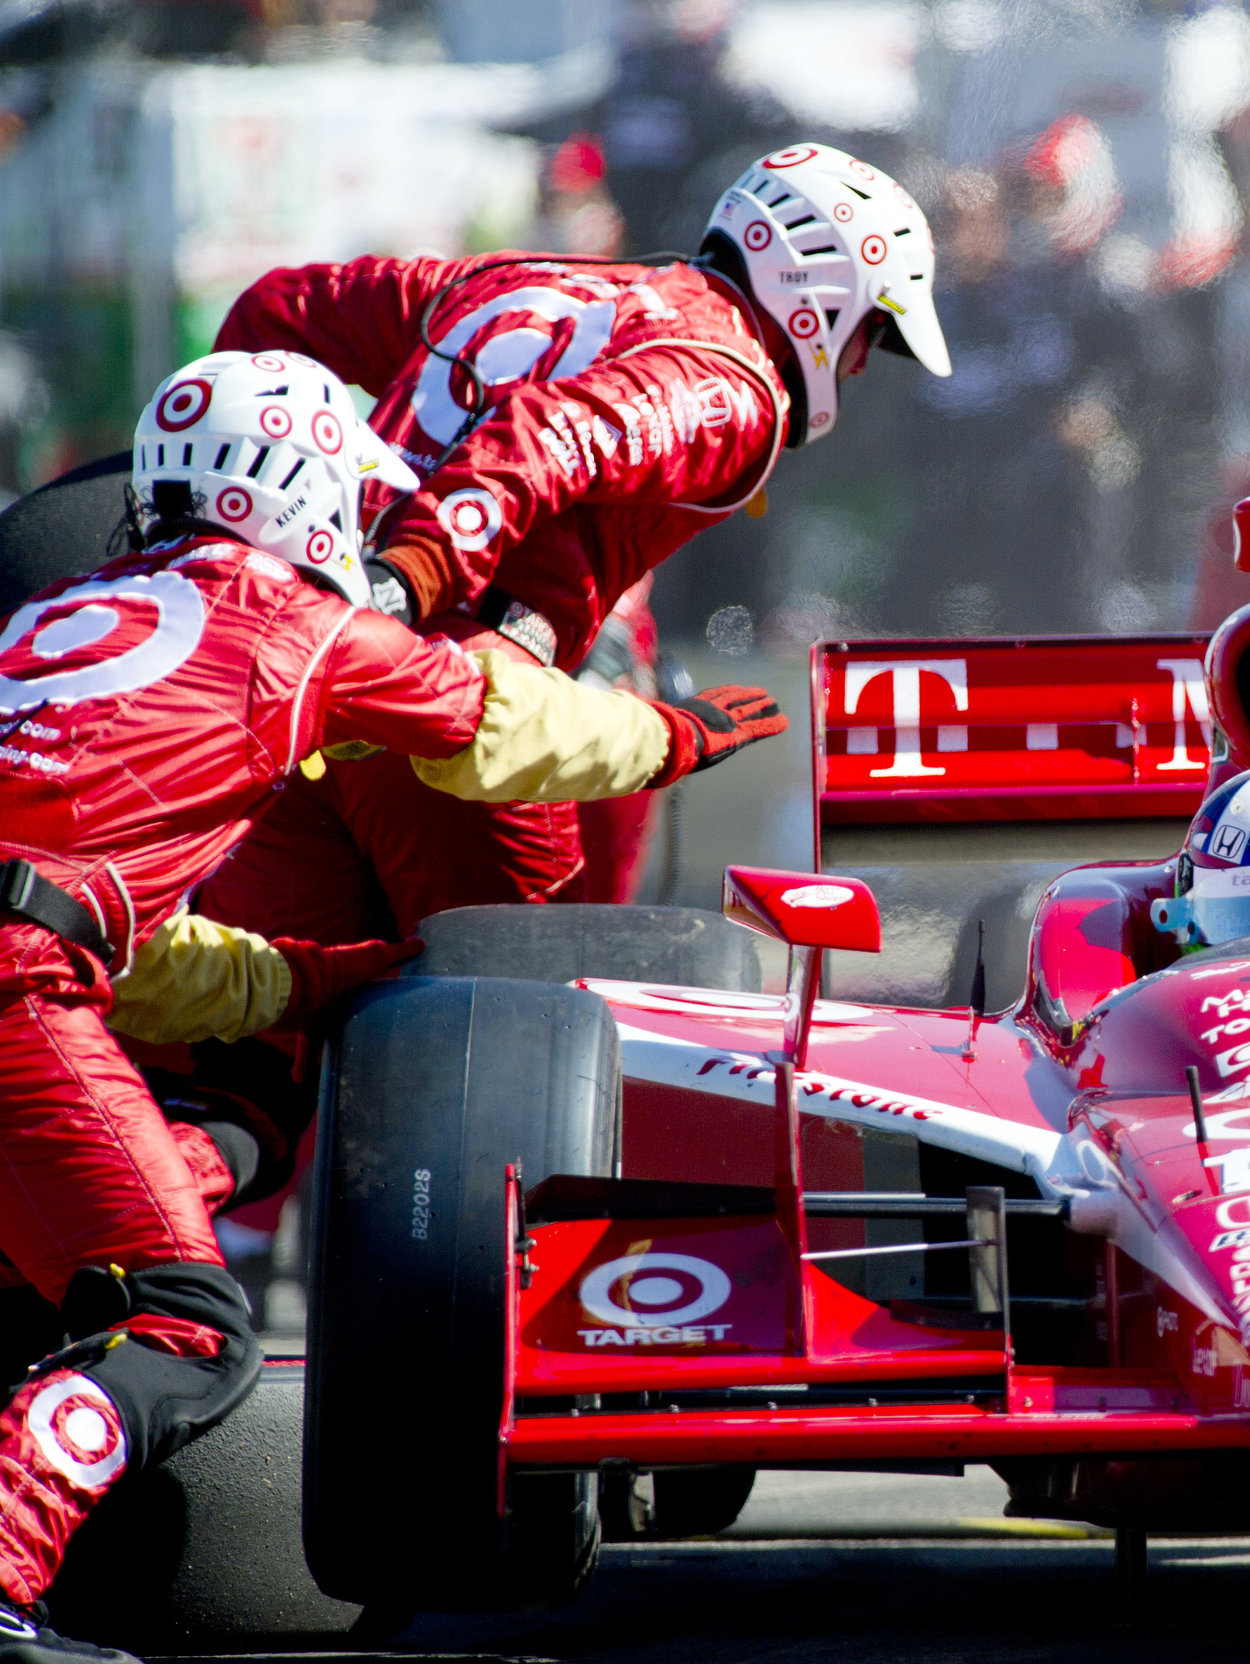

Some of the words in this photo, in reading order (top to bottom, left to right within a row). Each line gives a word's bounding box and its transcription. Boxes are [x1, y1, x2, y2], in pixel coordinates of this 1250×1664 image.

[779, 270, 809, 283] TROY
[275, 496, 307, 528] KEVIN
[696, 1057, 944, 1121] Firstone
[412, 1168, 432, 1240] B2202S
[577, 1324, 733, 1347] TARGET
